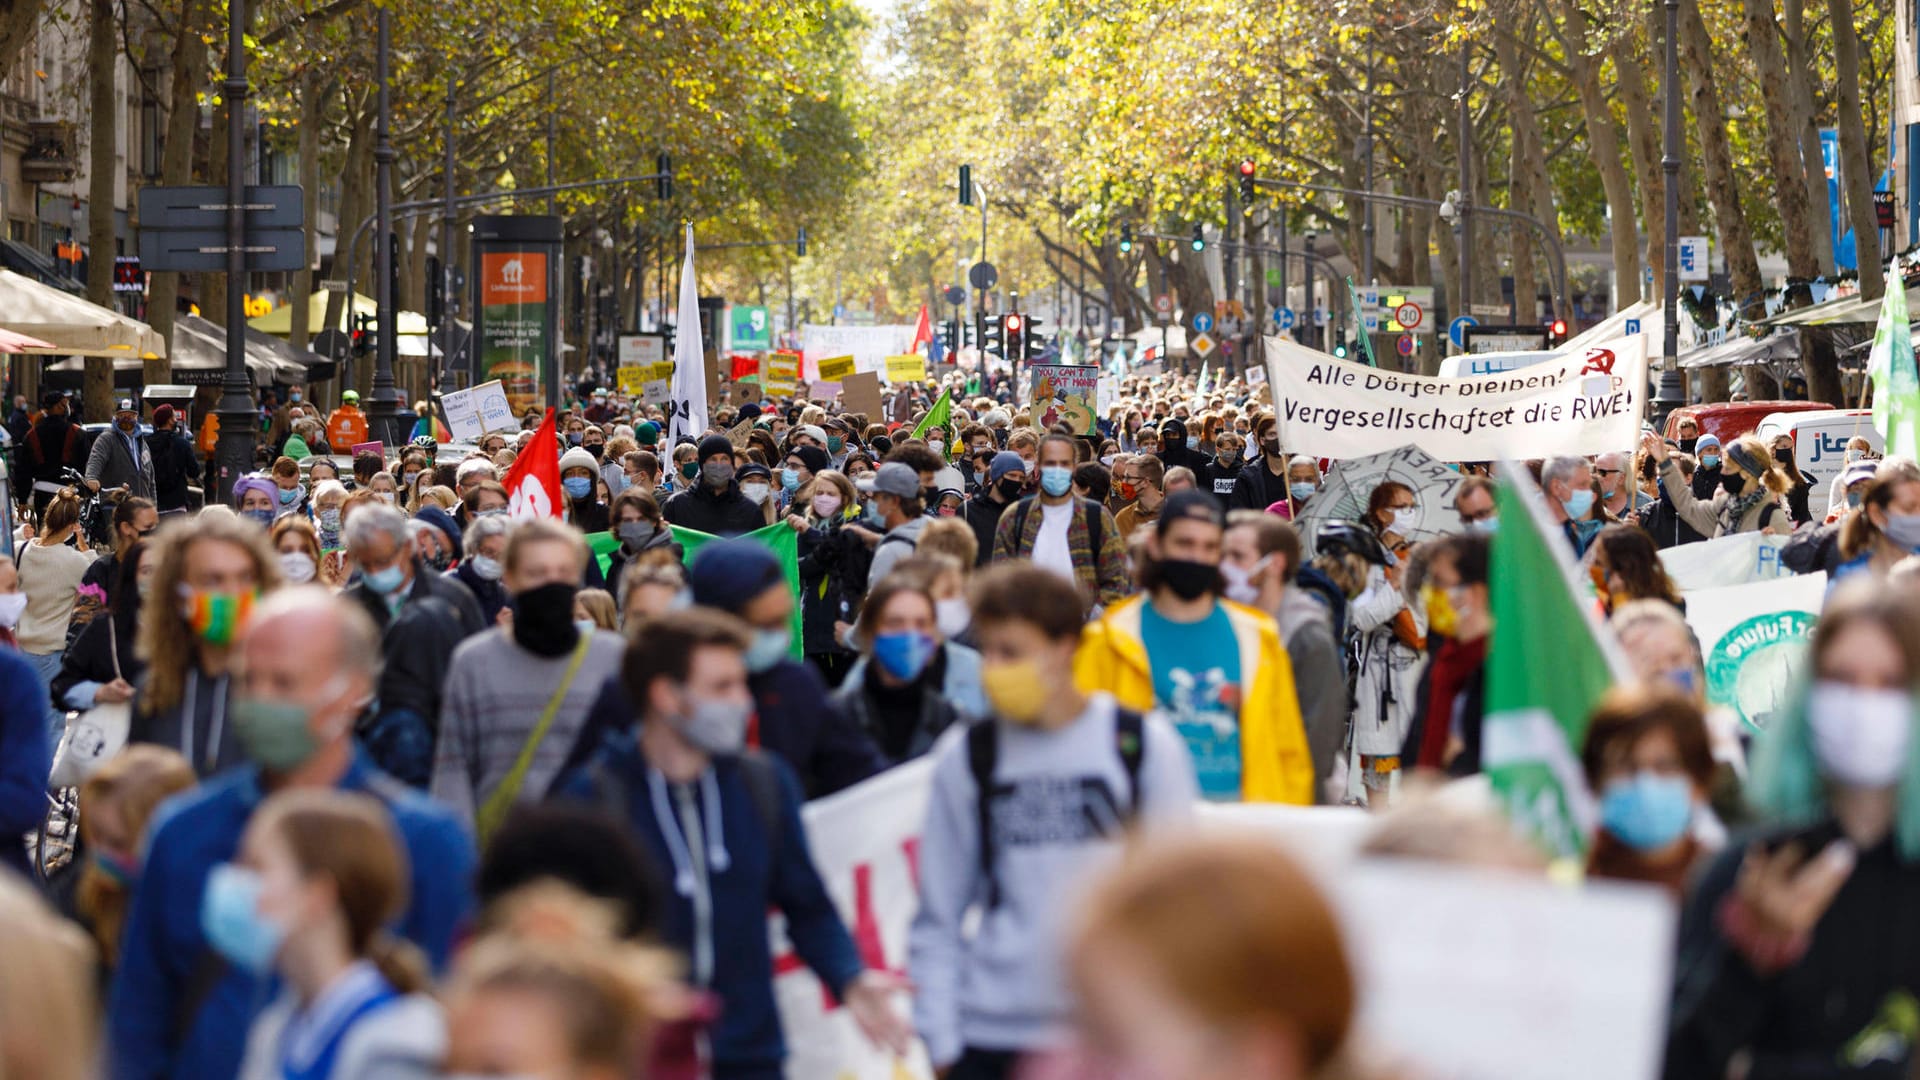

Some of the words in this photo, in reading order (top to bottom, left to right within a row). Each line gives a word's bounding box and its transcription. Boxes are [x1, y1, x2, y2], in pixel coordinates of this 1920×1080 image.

[1401, 310, 1417, 322] 30
[1038, 368, 1053, 377] YOU
[1047, 376, 1069, 388] EAT
[1073, 377, 1097, 390] MONEY
[1307, 364, 1355, 386] Alle
[1365, 374, 1450, 398] Dörfer
[1285, 397, 1515, 434] Vergesellschaftet
[1524, 403, 1562, 424] die
[1572, 389, 1632, 420] RWE!
